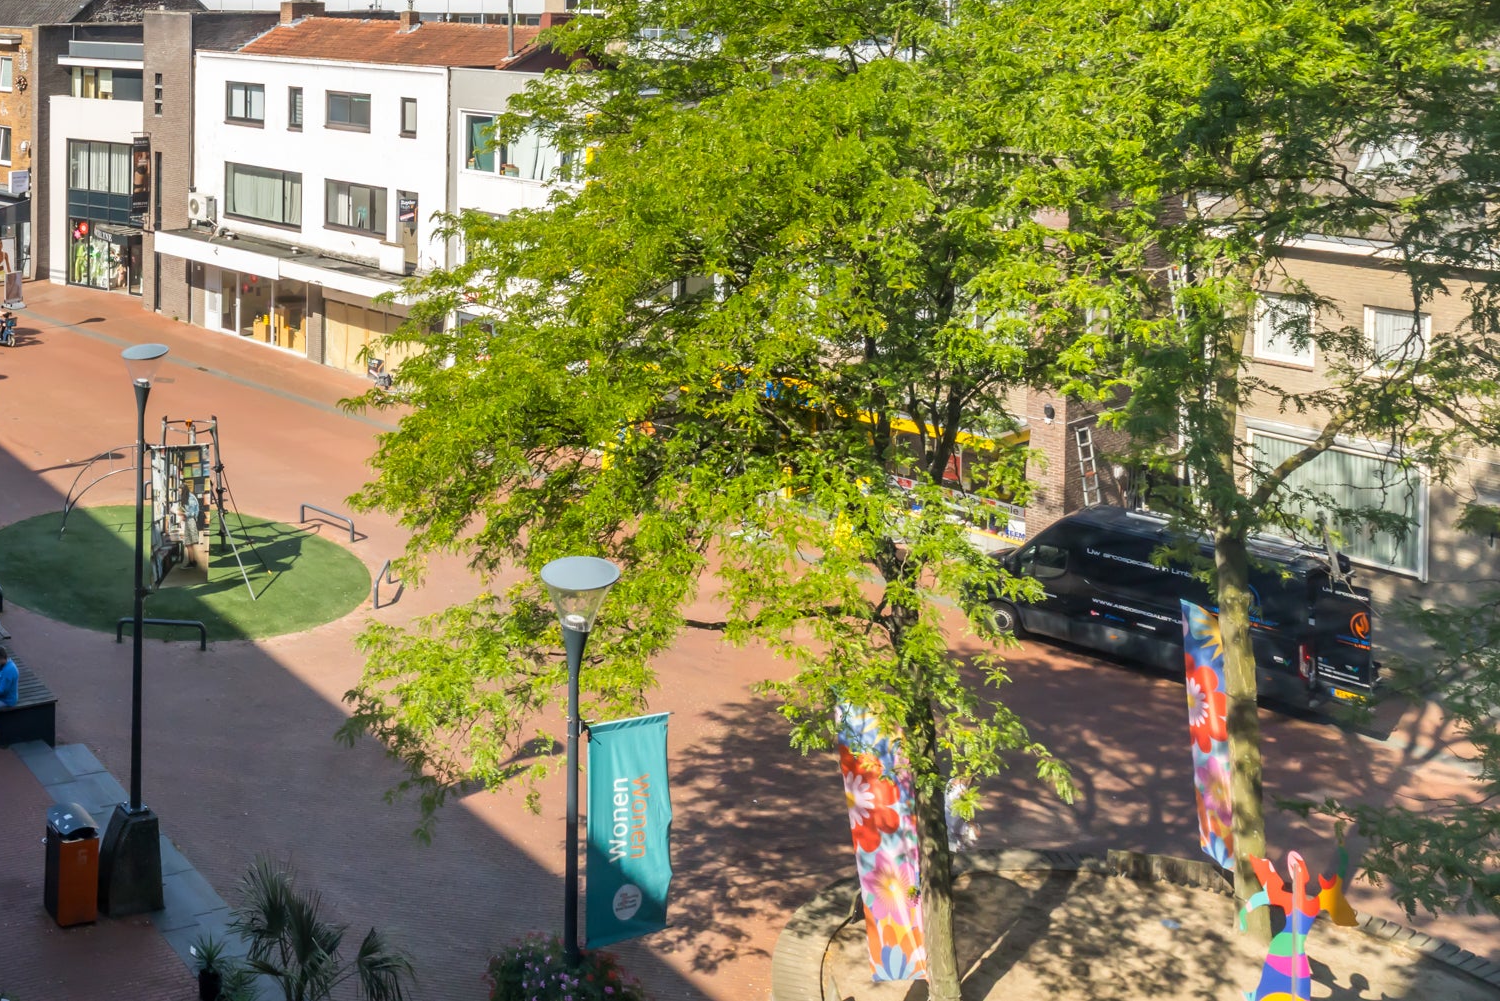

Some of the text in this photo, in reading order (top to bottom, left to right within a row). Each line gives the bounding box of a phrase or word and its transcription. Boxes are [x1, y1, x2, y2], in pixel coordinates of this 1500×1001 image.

[1086, 547, 1100, 556] Uw
[608, 777, 629, 863] Wonen
[630, 773, 650, 859] Wonen
